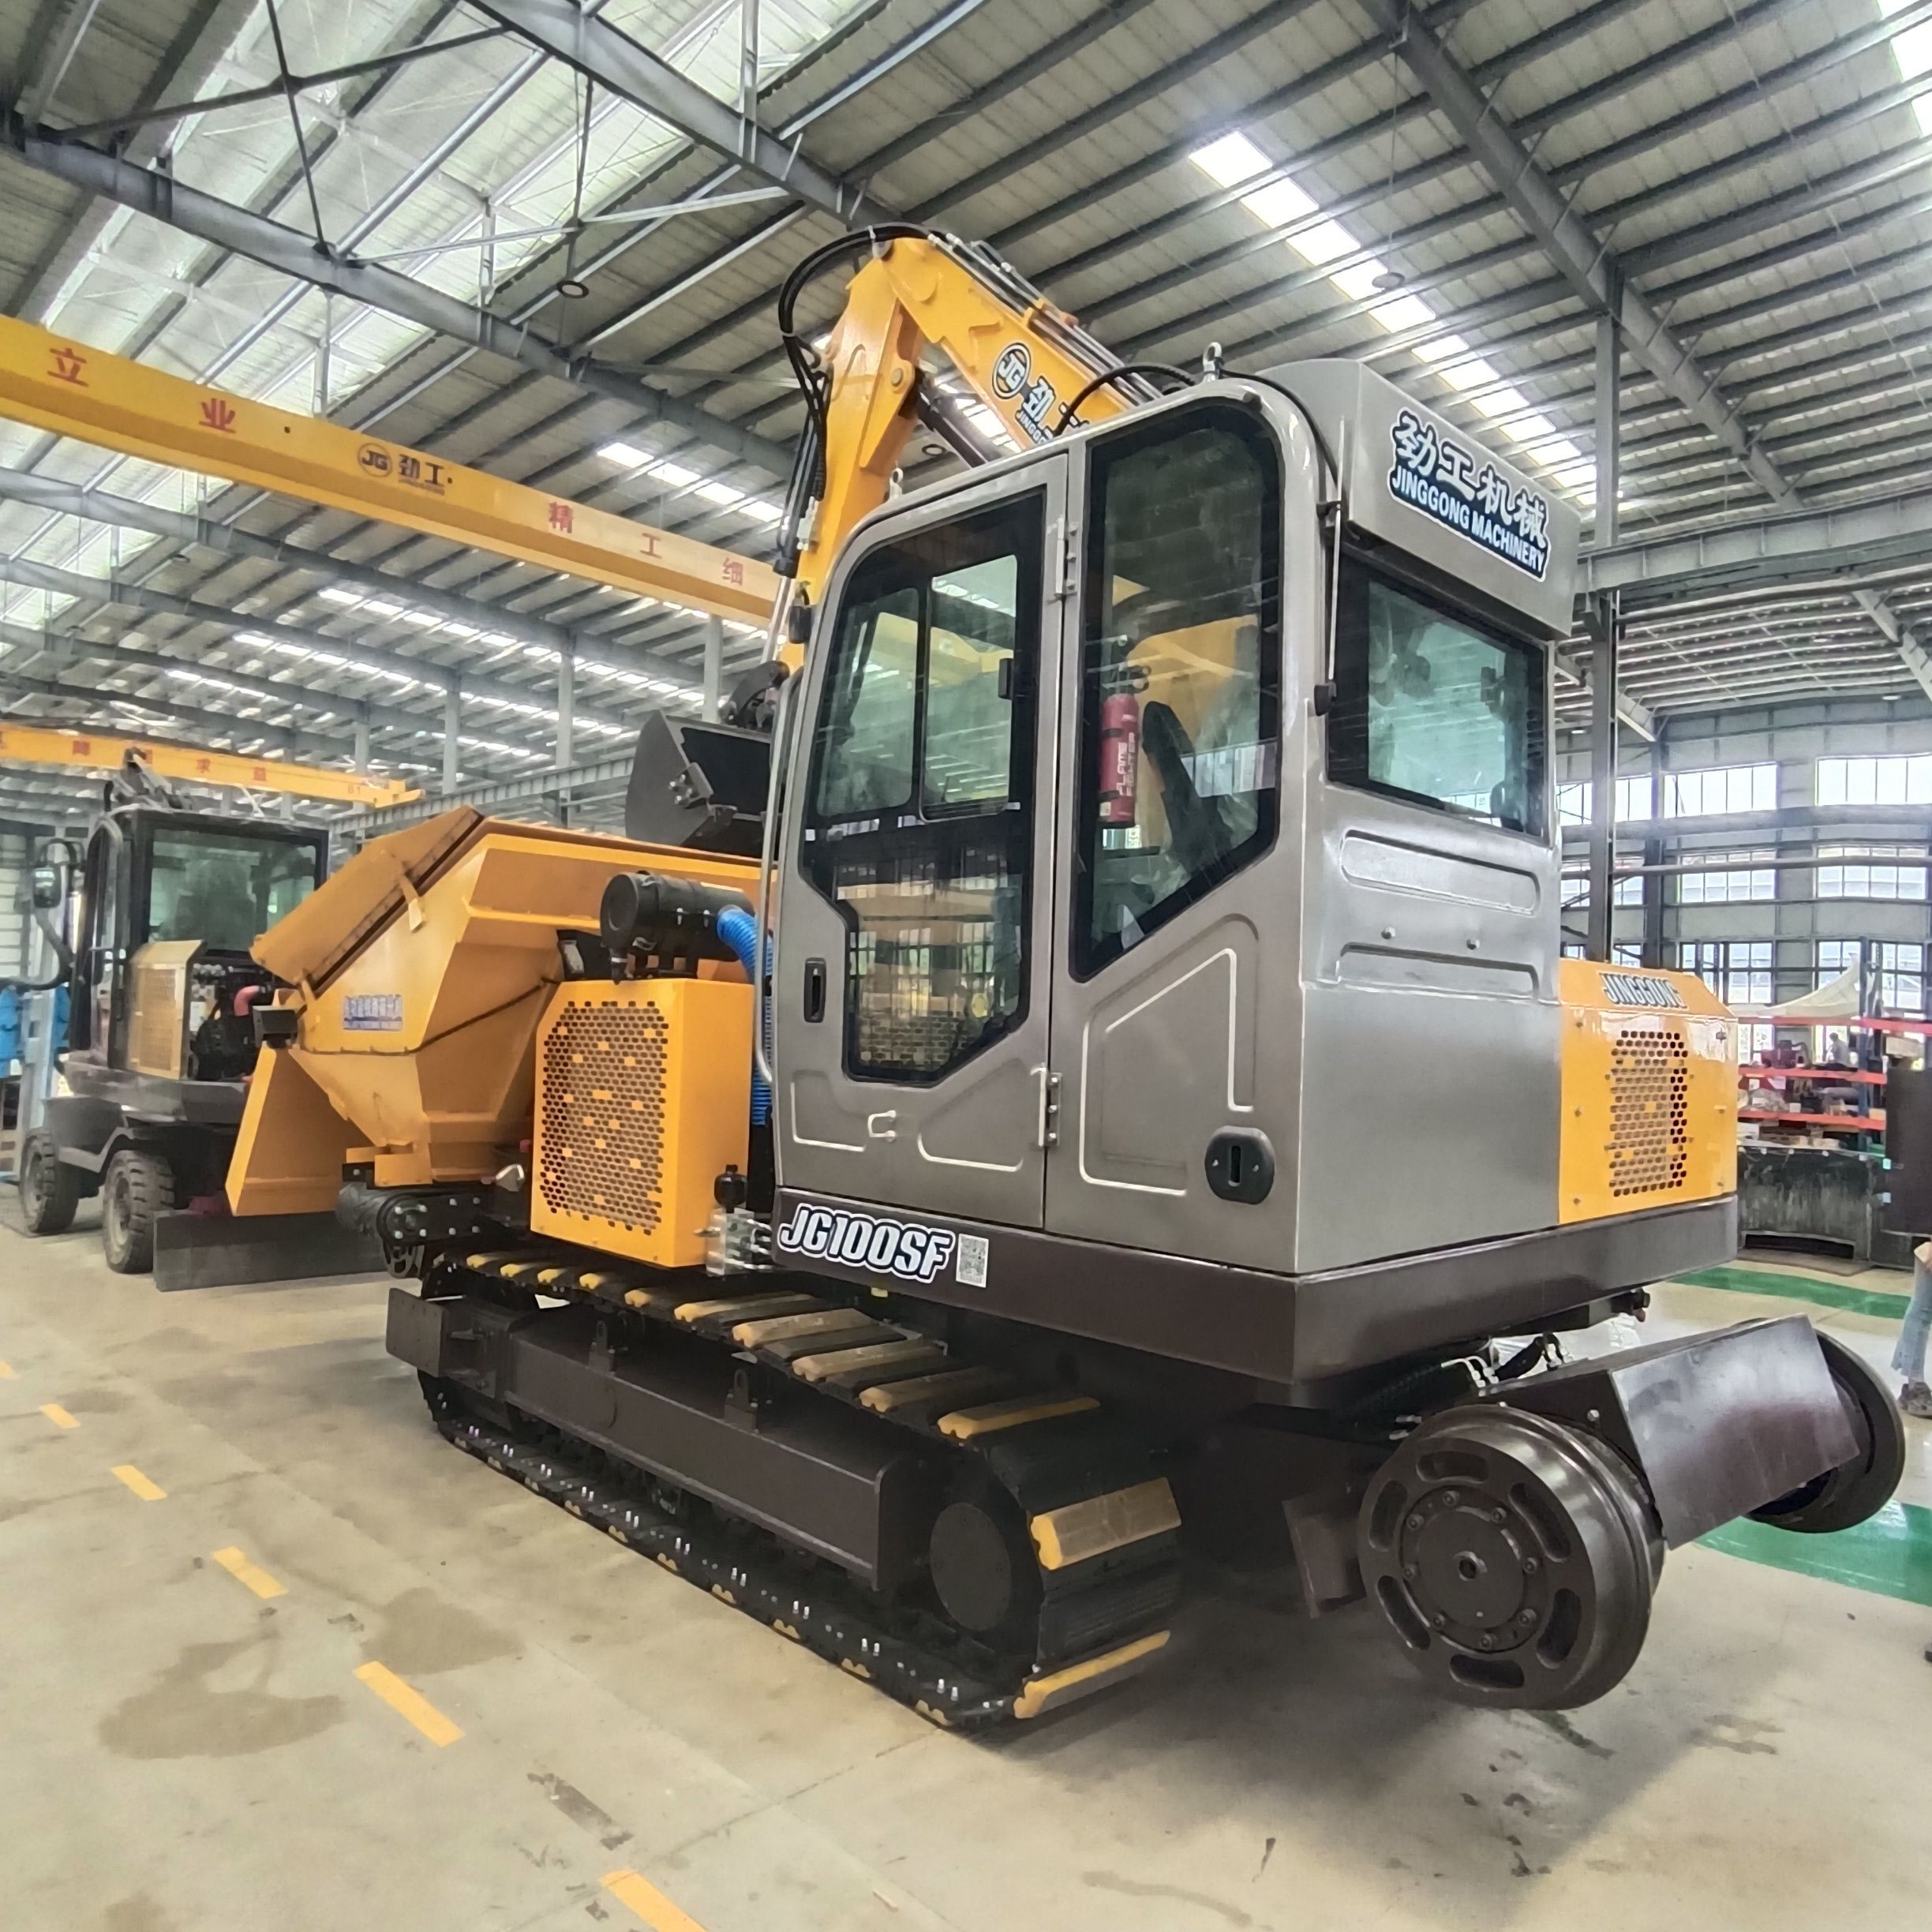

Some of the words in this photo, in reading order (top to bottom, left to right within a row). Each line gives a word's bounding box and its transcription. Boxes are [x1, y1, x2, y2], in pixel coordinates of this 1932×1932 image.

[996, 350, 1028, 392] JG
[361, 448, 388, 472] JG
[398, 453, 445, 488] 劲工
[1394, 414, 1547, 549] 劲工机械
[1391, 465, 1470, 530] JINGGONG
[1471, 510, 1545, 573] MACHINERY
[1601, 972, 1687, 1008] JINGGONG
[780, 1208, 951, 1277] JG100SF
